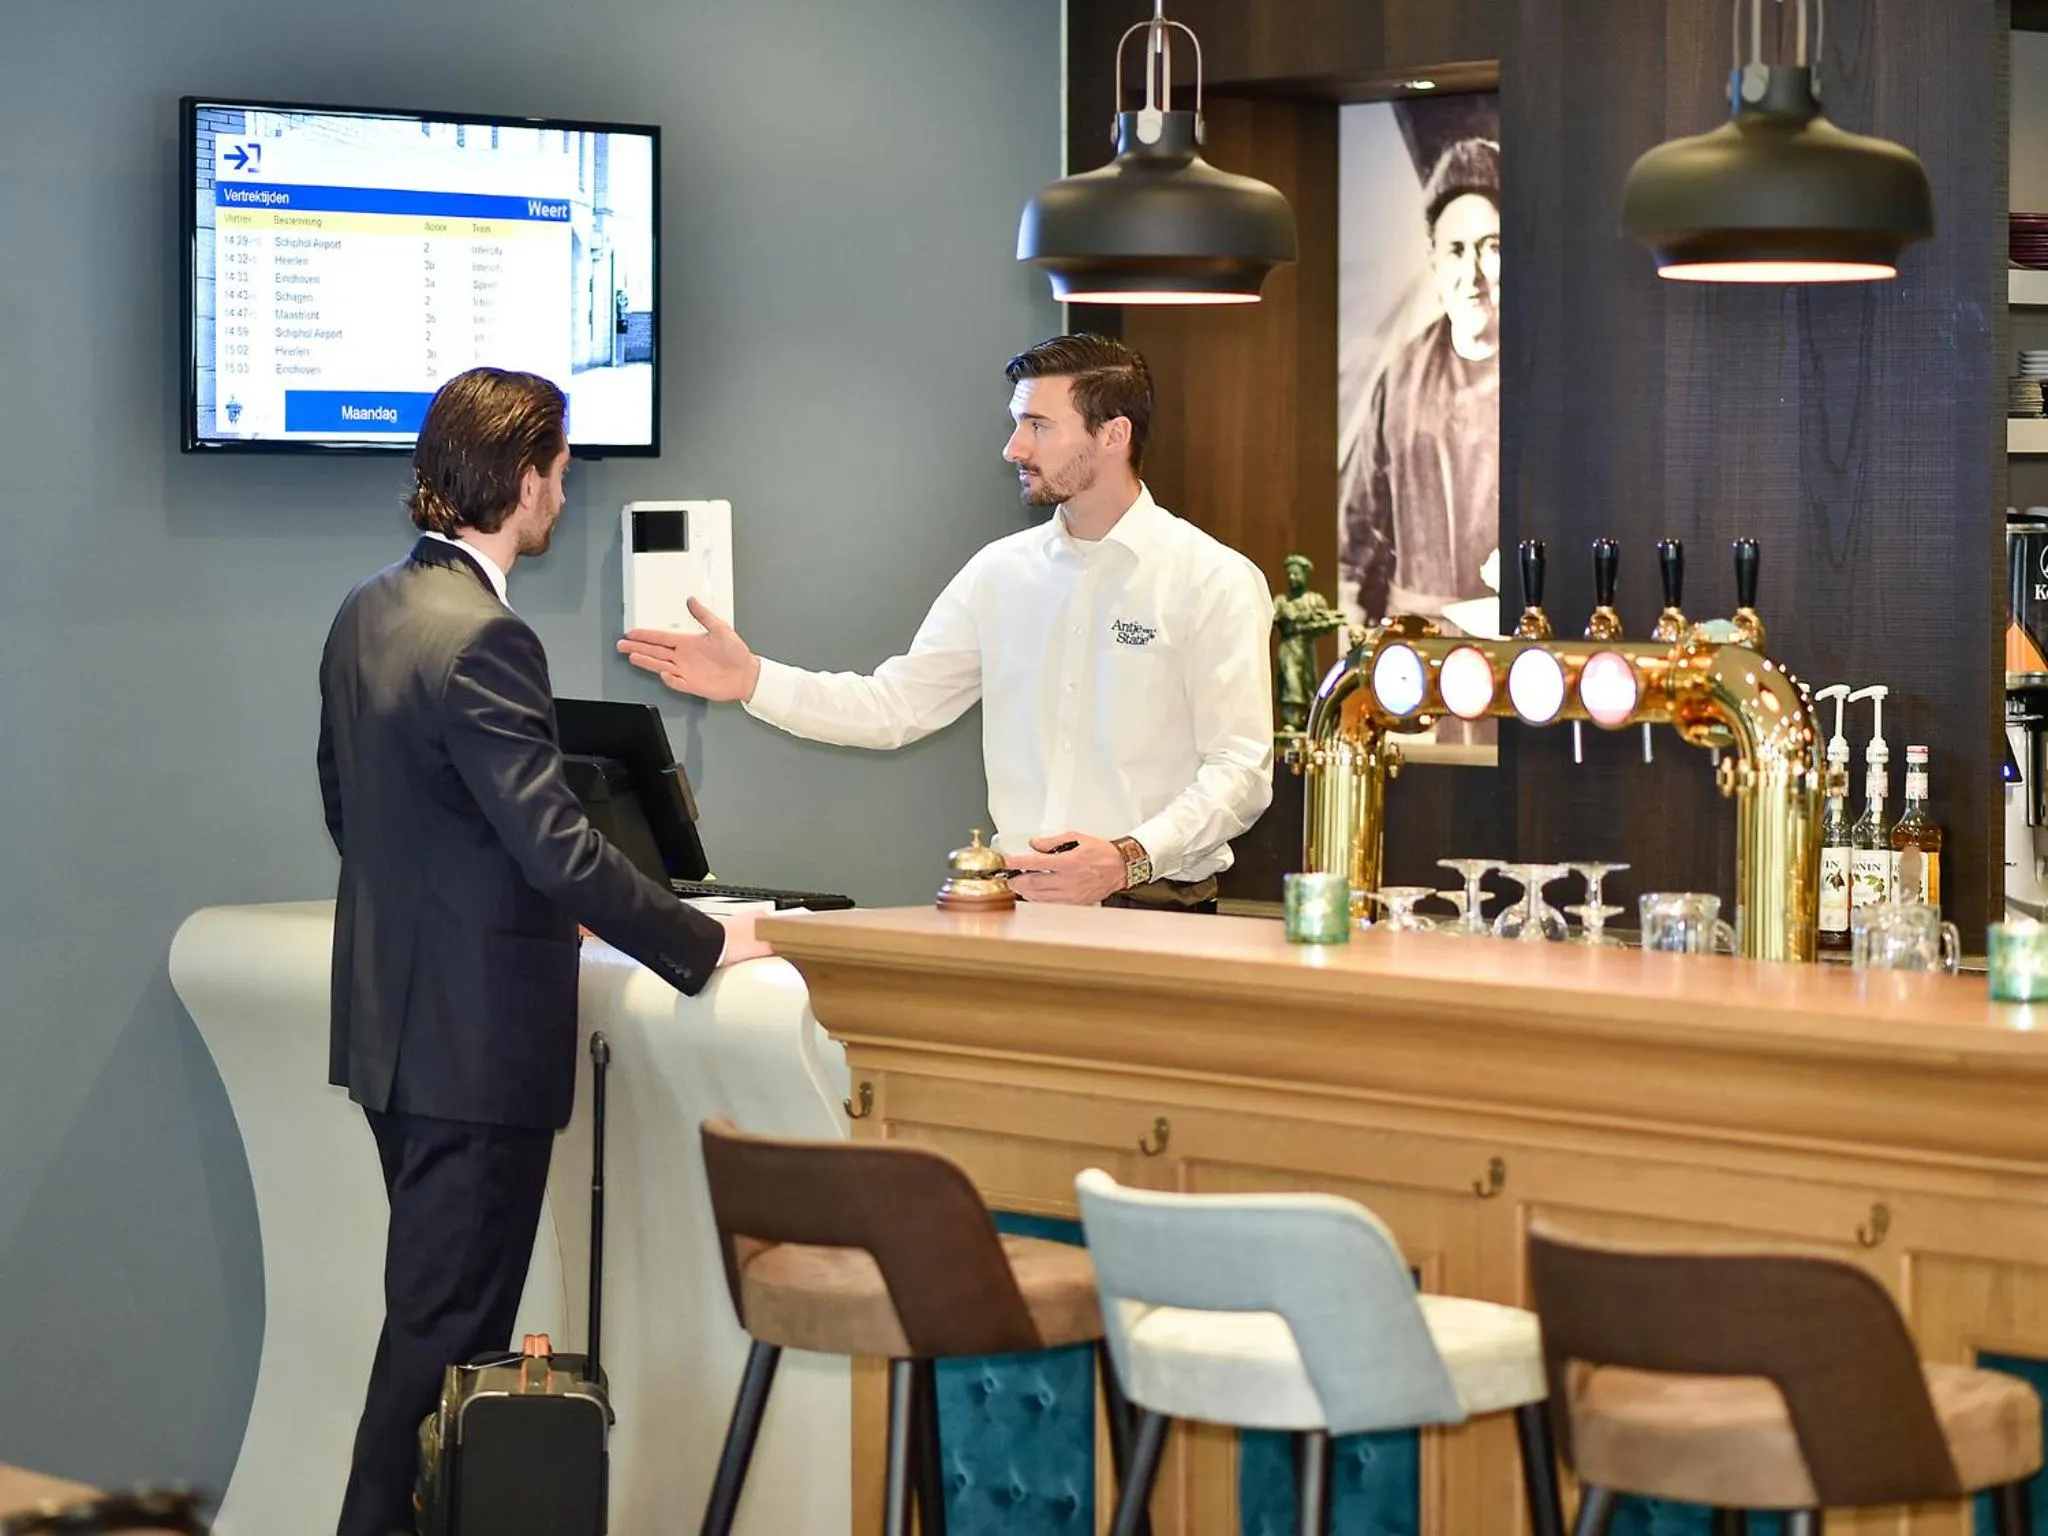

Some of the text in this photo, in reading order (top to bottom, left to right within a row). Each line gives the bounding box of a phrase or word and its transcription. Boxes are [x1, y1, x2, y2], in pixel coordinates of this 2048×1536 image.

[223, 188, 290, 206] Vertrektijden
[527, 201, 568, 218] Weert
[274, 237, 313, 249] Schiphol
[313, 239, 342, 250] Airport
[423, 242, 430, 253] 2
[275, 273, 320, 284] Eindhoven
[275, 292, 314, 304] Schagen
[425, 295, 431, 306] 2
[275, 309, 320, 320] Maastricht
[425, 331, 431, 342] 2
[341, 404, 397, 423] Maandag
